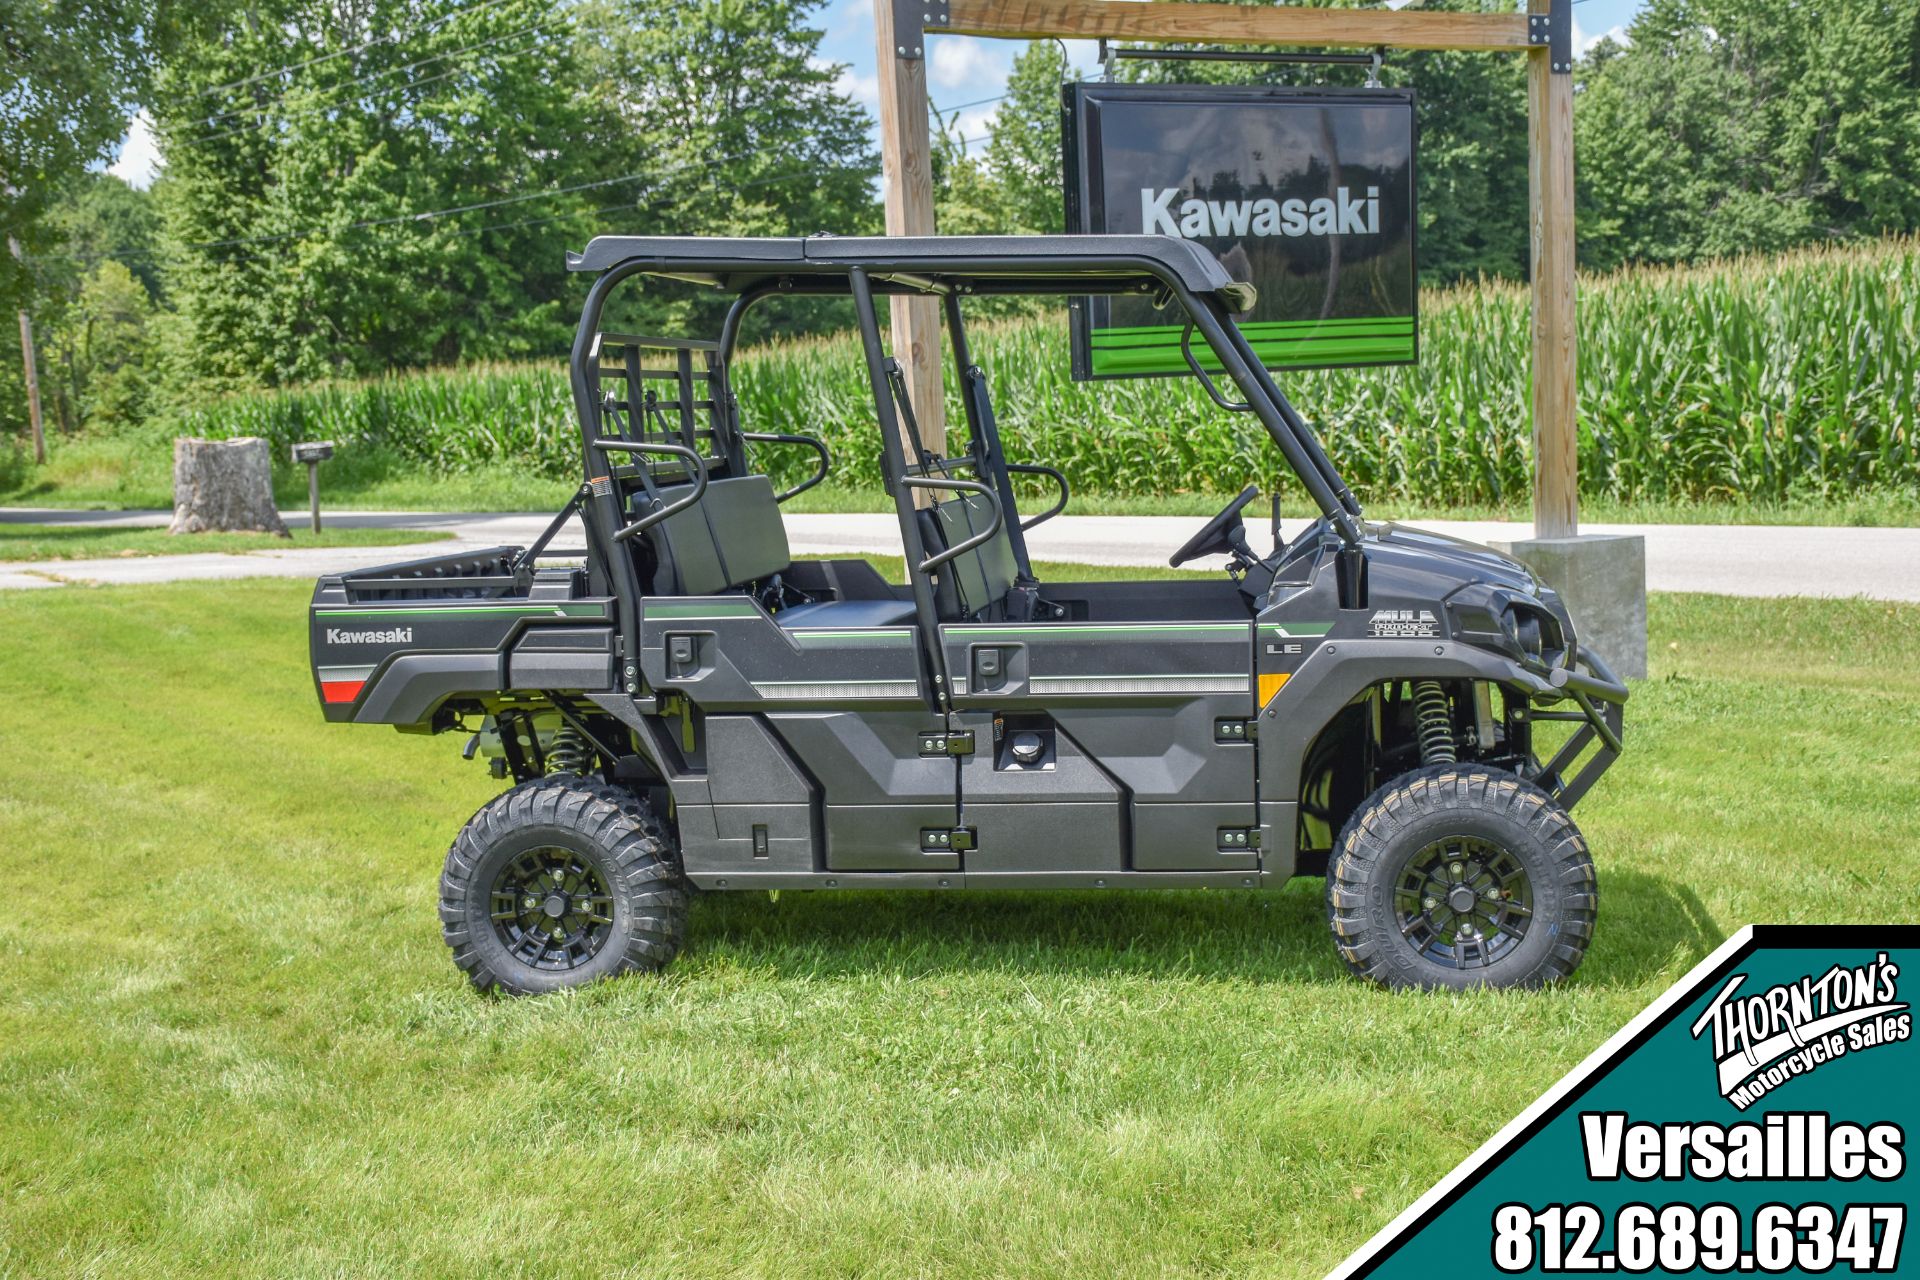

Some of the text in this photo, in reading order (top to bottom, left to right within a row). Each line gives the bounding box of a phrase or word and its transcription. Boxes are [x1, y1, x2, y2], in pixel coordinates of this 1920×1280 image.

[1140, 186, 1380, 238] Kawasaki
[326, 627, 413, 644] Kawasaki
[1266, 644, 1303, 654] LE
[1371, 883, 1417, 970] DURO
